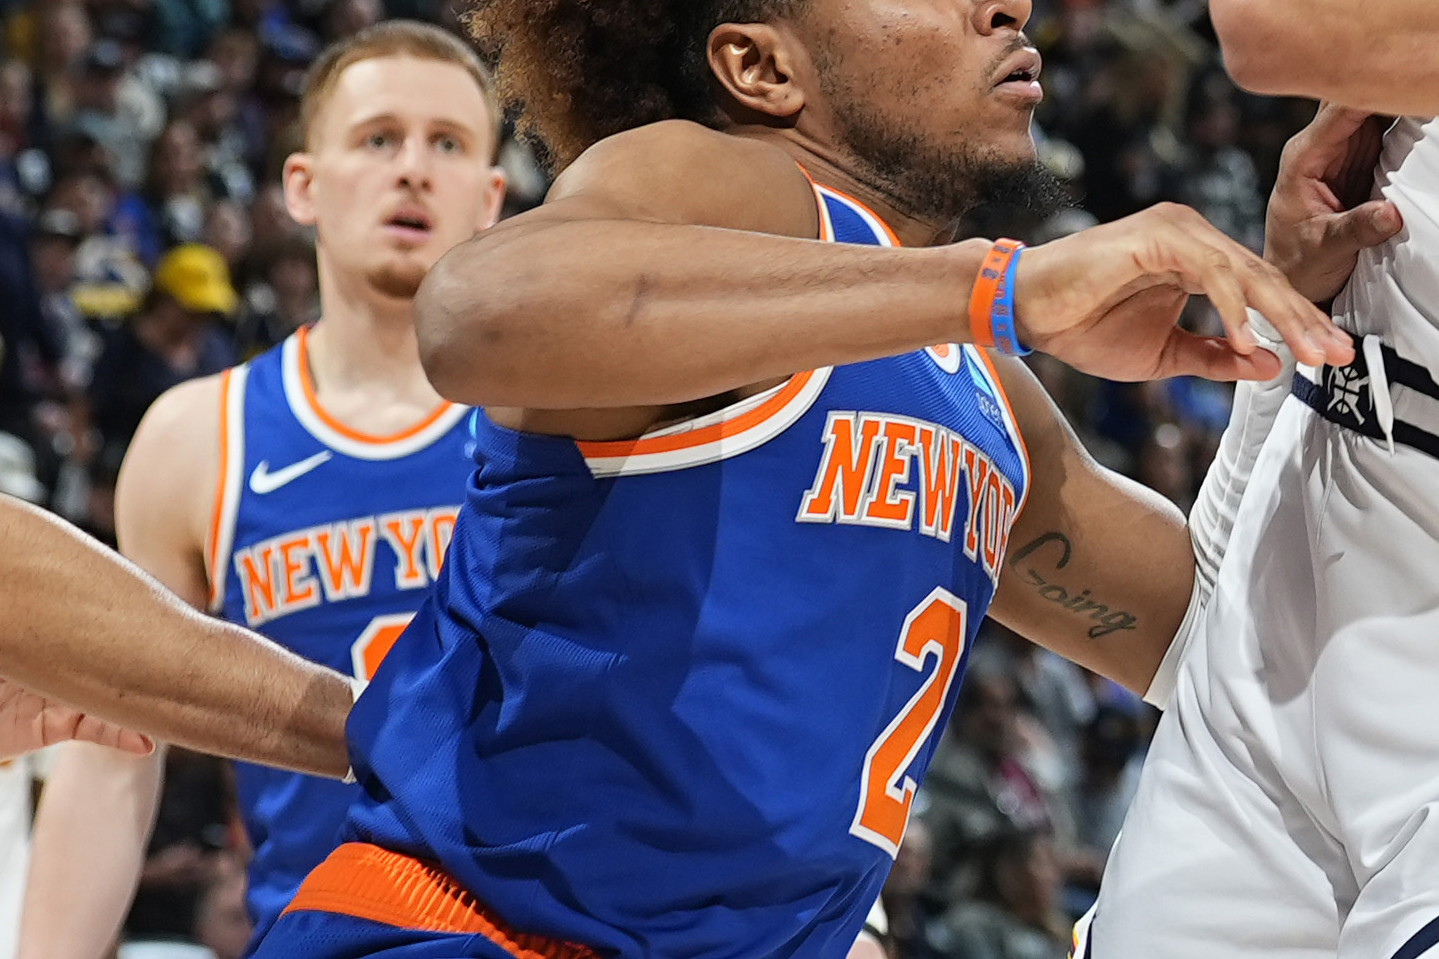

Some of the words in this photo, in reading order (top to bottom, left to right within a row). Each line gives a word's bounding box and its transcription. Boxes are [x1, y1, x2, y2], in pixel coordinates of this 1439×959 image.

[795, 410, 963, 543] NEW
[234, 516, 378, 628] NEW
[1010, 532, 1137, 639] Going
[849, 585, 967, 861] 2
